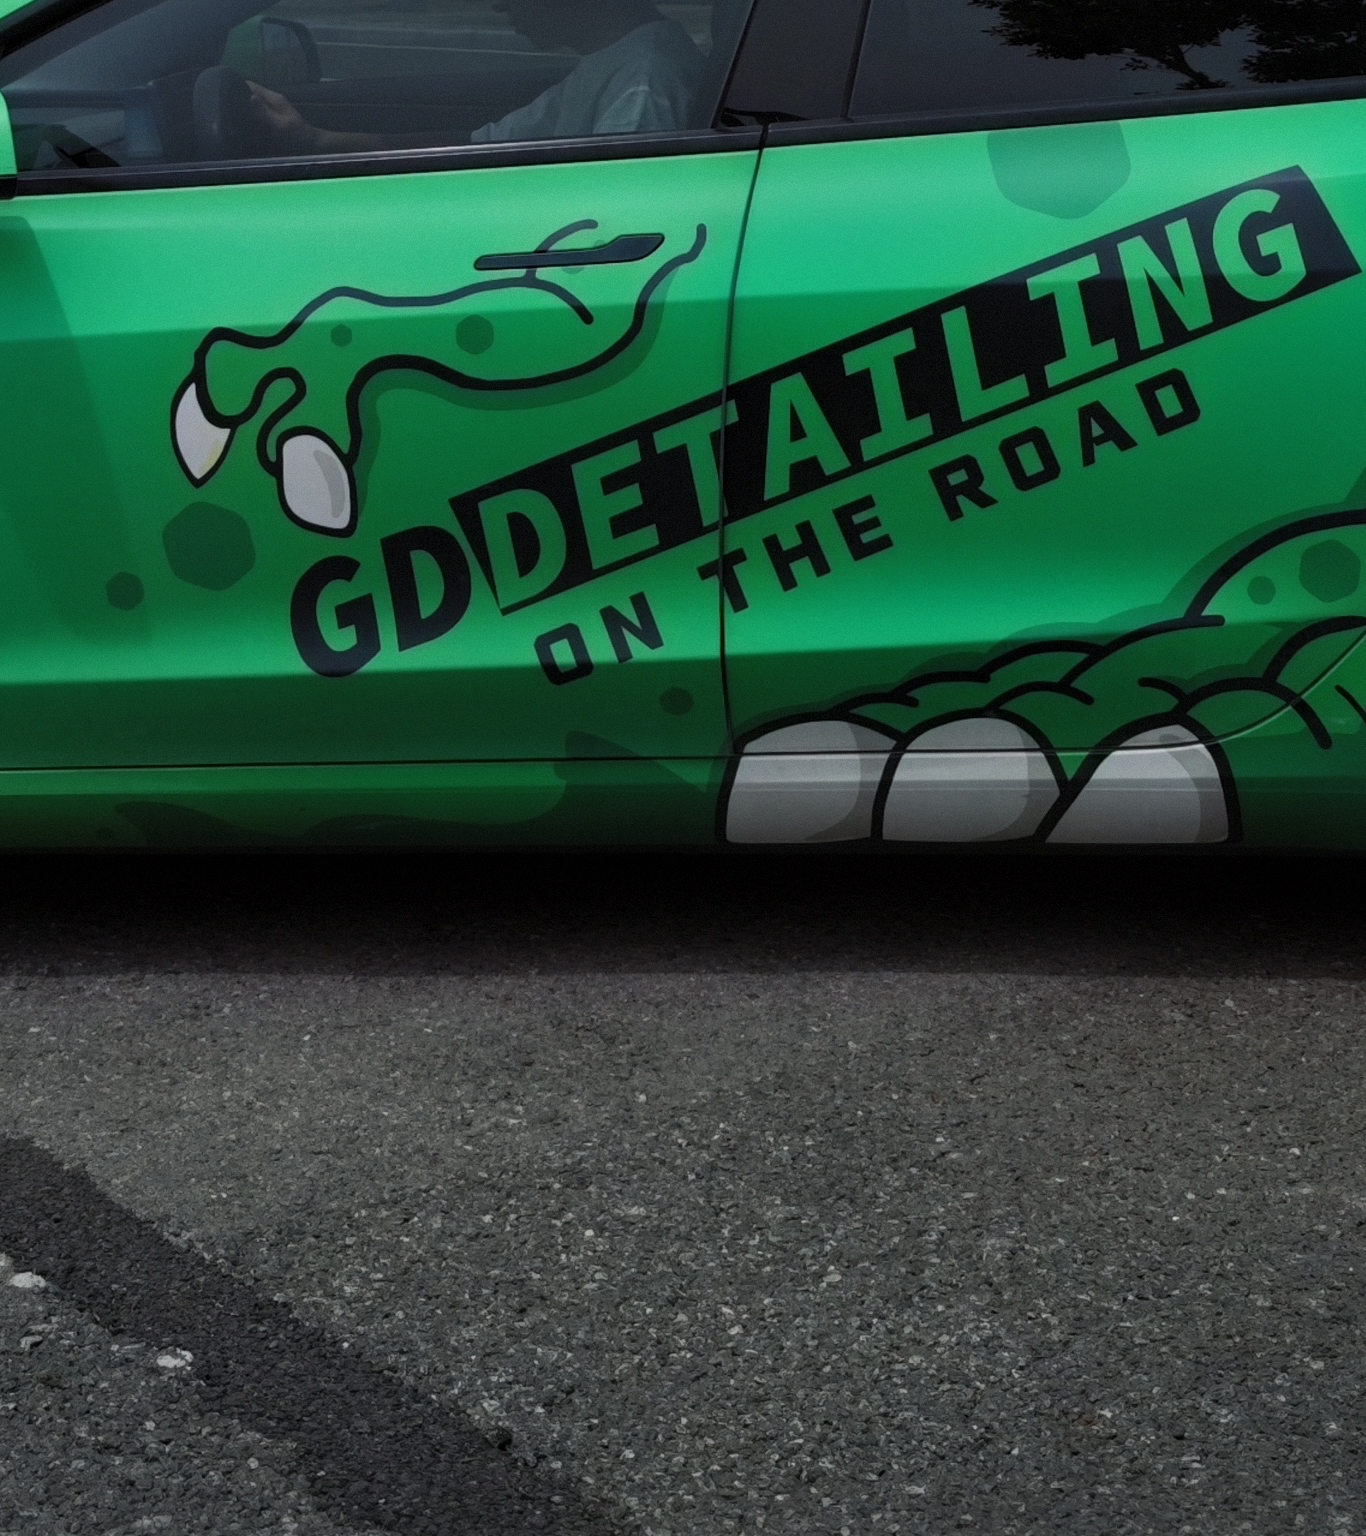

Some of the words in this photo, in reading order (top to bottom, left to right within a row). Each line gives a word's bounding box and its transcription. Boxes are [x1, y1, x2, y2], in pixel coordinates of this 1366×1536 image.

[533, 592, 665, 686] ON
[697, 494, 895, 614] THE
[928, 367, 1202, 522] ROAD
